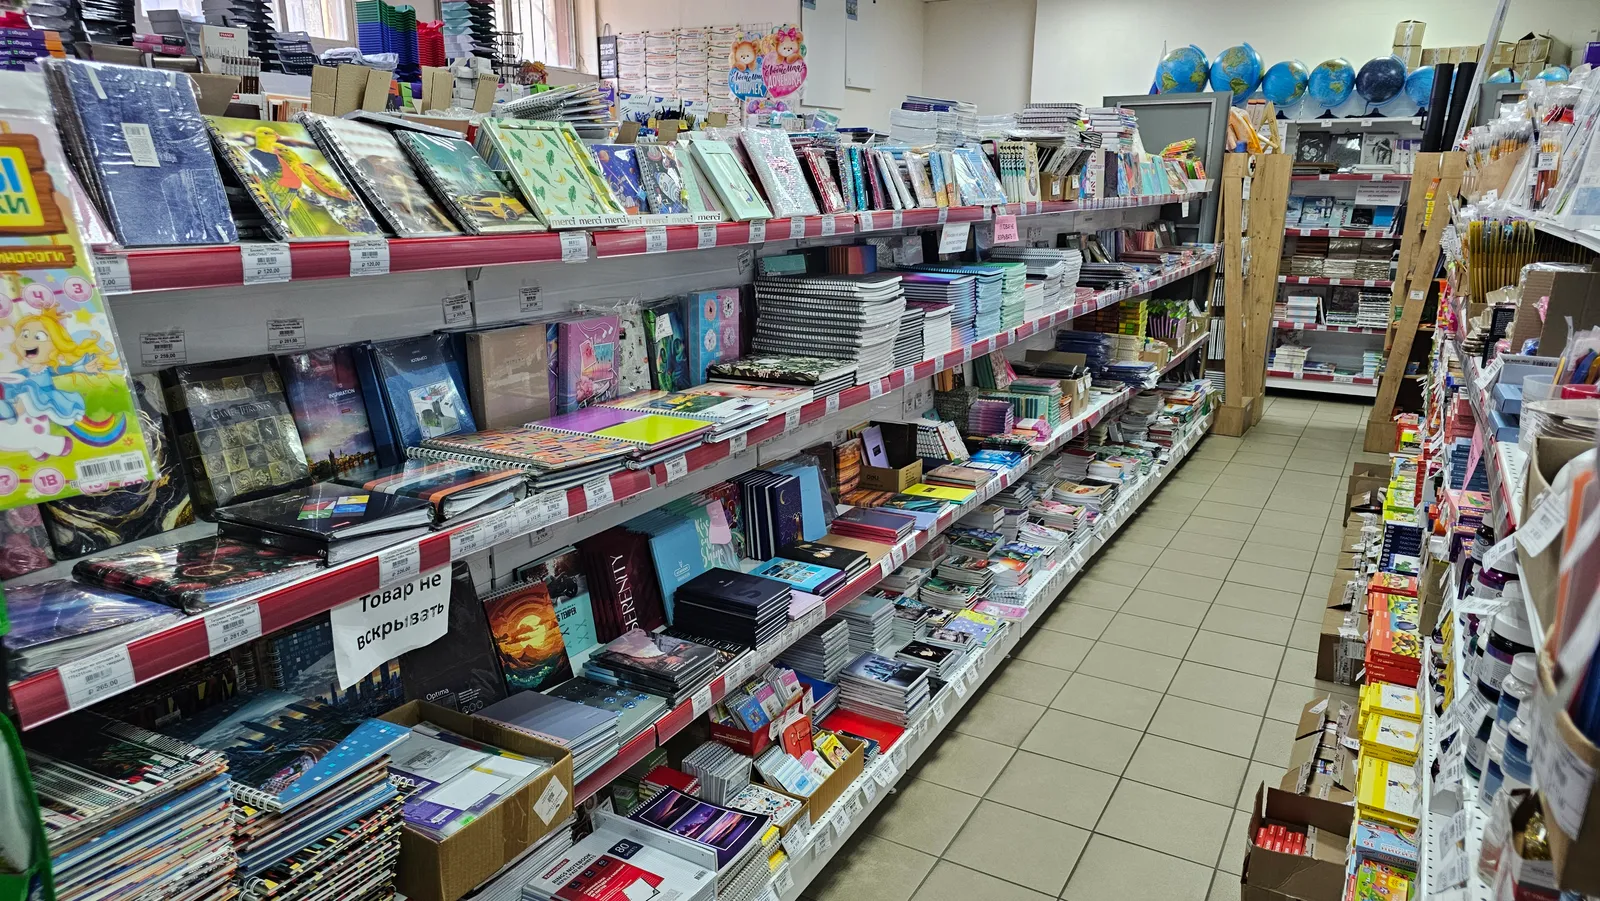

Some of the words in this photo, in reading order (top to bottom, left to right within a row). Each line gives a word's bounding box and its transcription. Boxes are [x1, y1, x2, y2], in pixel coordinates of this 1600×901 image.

[552, 217, 576, 226] merci
[579, 216, 601, 225] merci
[604, 215, 627, 224] merci
[645, 216, 668, 224] merci
[697, 213, 721, 221] merci
[72, 283, 84, 294] 3
[328, 388, 356, 399] INSPIRATION
[210, 408, 232, 420] GAME
[239, 402, 272, 416] THRONES
[40, 474, 58, 487] 18
[359, 582, 414, 612] Товар
[420, 574, 441, 591] не
[610, 554, 640, 631] SERENITY
[357, 603, 444, 650] вскрывать
[426, 688, 450, 700] Optima
[615, 843, 629, 852] 80
[566, 853, 592, 873] NOTEBOOK
